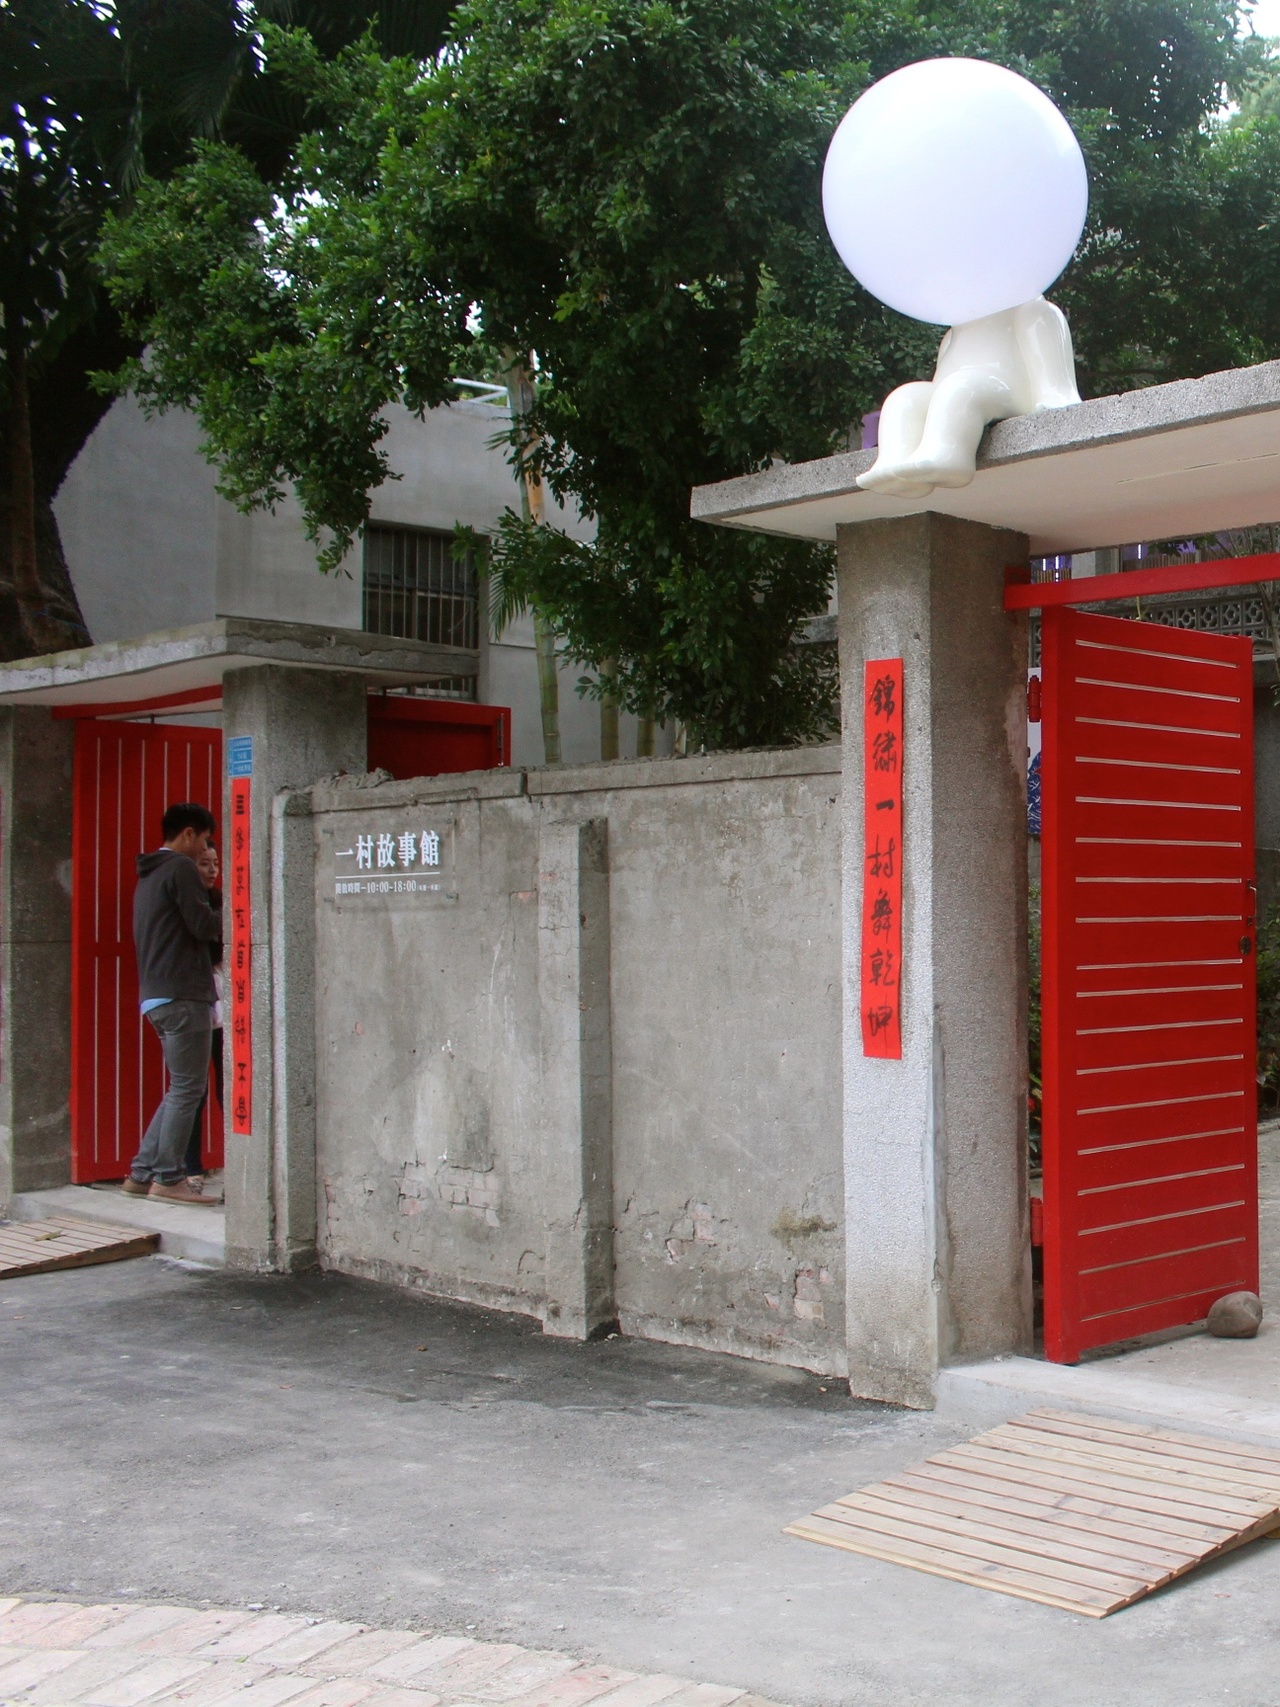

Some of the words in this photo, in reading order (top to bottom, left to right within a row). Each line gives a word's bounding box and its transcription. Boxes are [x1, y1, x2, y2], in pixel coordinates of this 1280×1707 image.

[335, 830, 440, 869] 一村故事館
